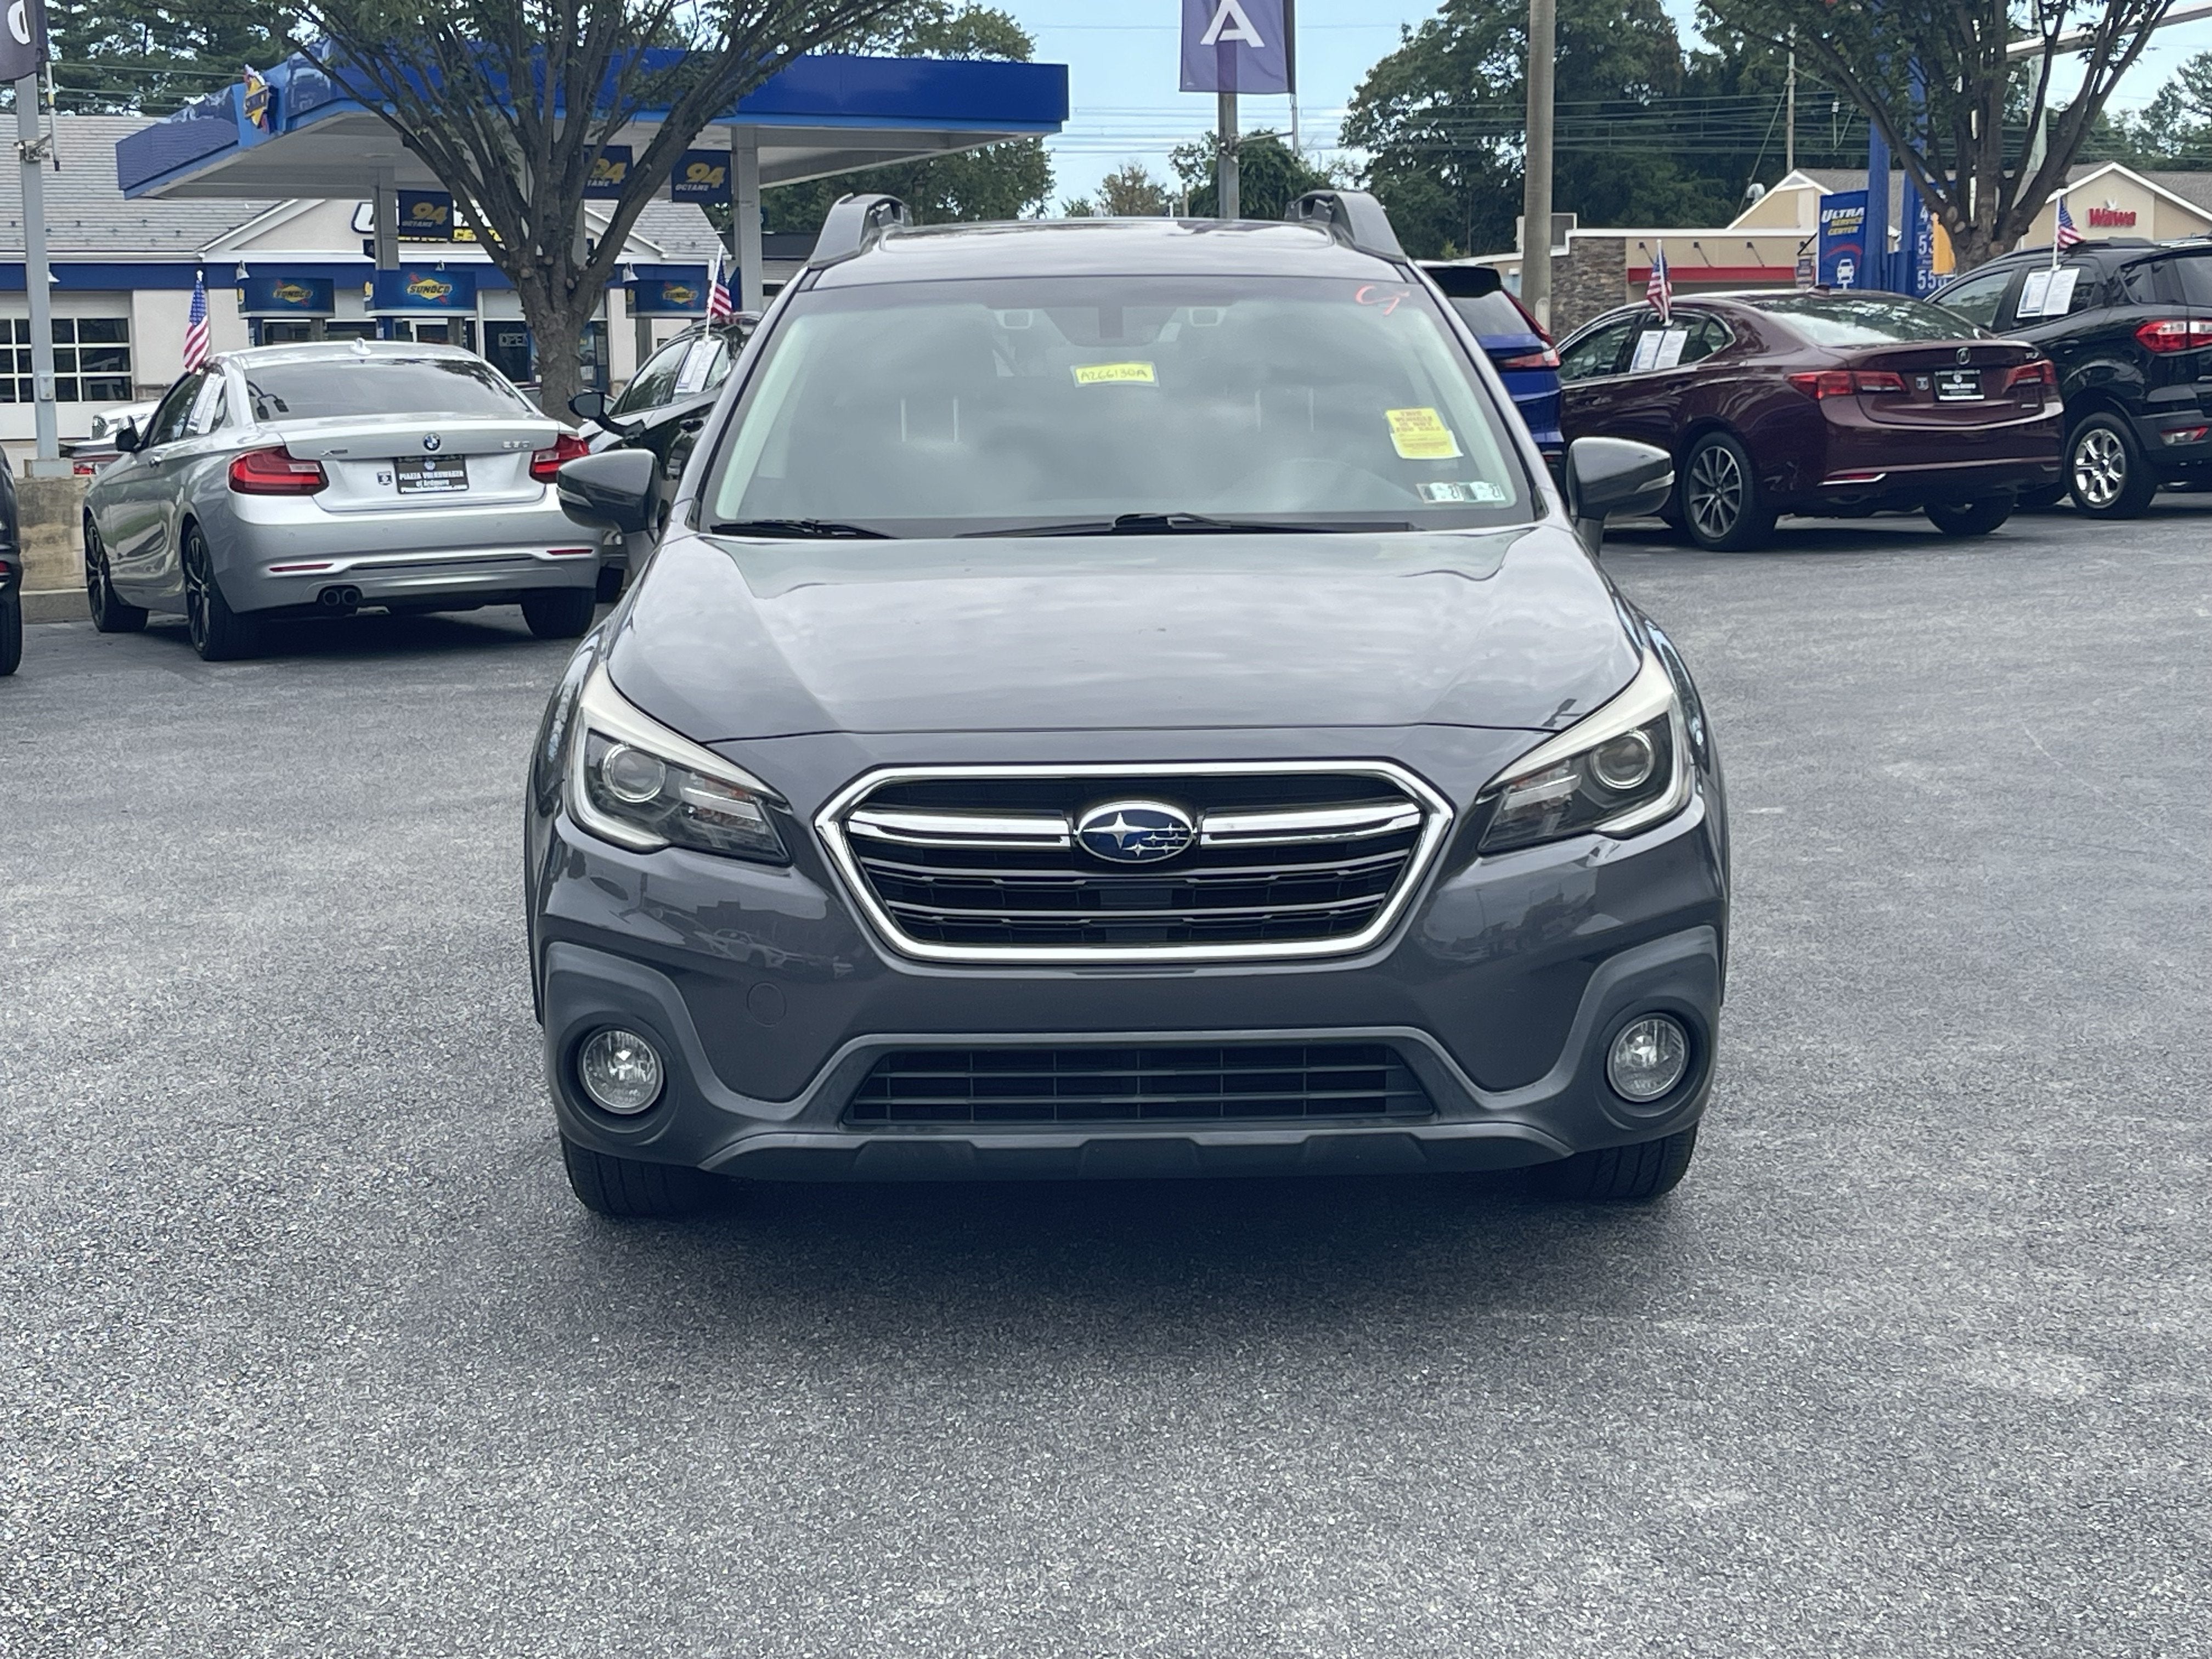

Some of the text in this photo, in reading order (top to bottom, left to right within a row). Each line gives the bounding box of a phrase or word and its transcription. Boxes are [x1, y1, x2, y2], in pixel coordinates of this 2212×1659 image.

[586, 179, 610, 188] TANE
[686, 162, 726, 188] 94
[412, 202, 448, 225] 94
[1821, 206, 1865, 223] ULTRA
[2089, 208, 2136, 227] Wawa
[409, 284, 452, 295] SUNOCO
